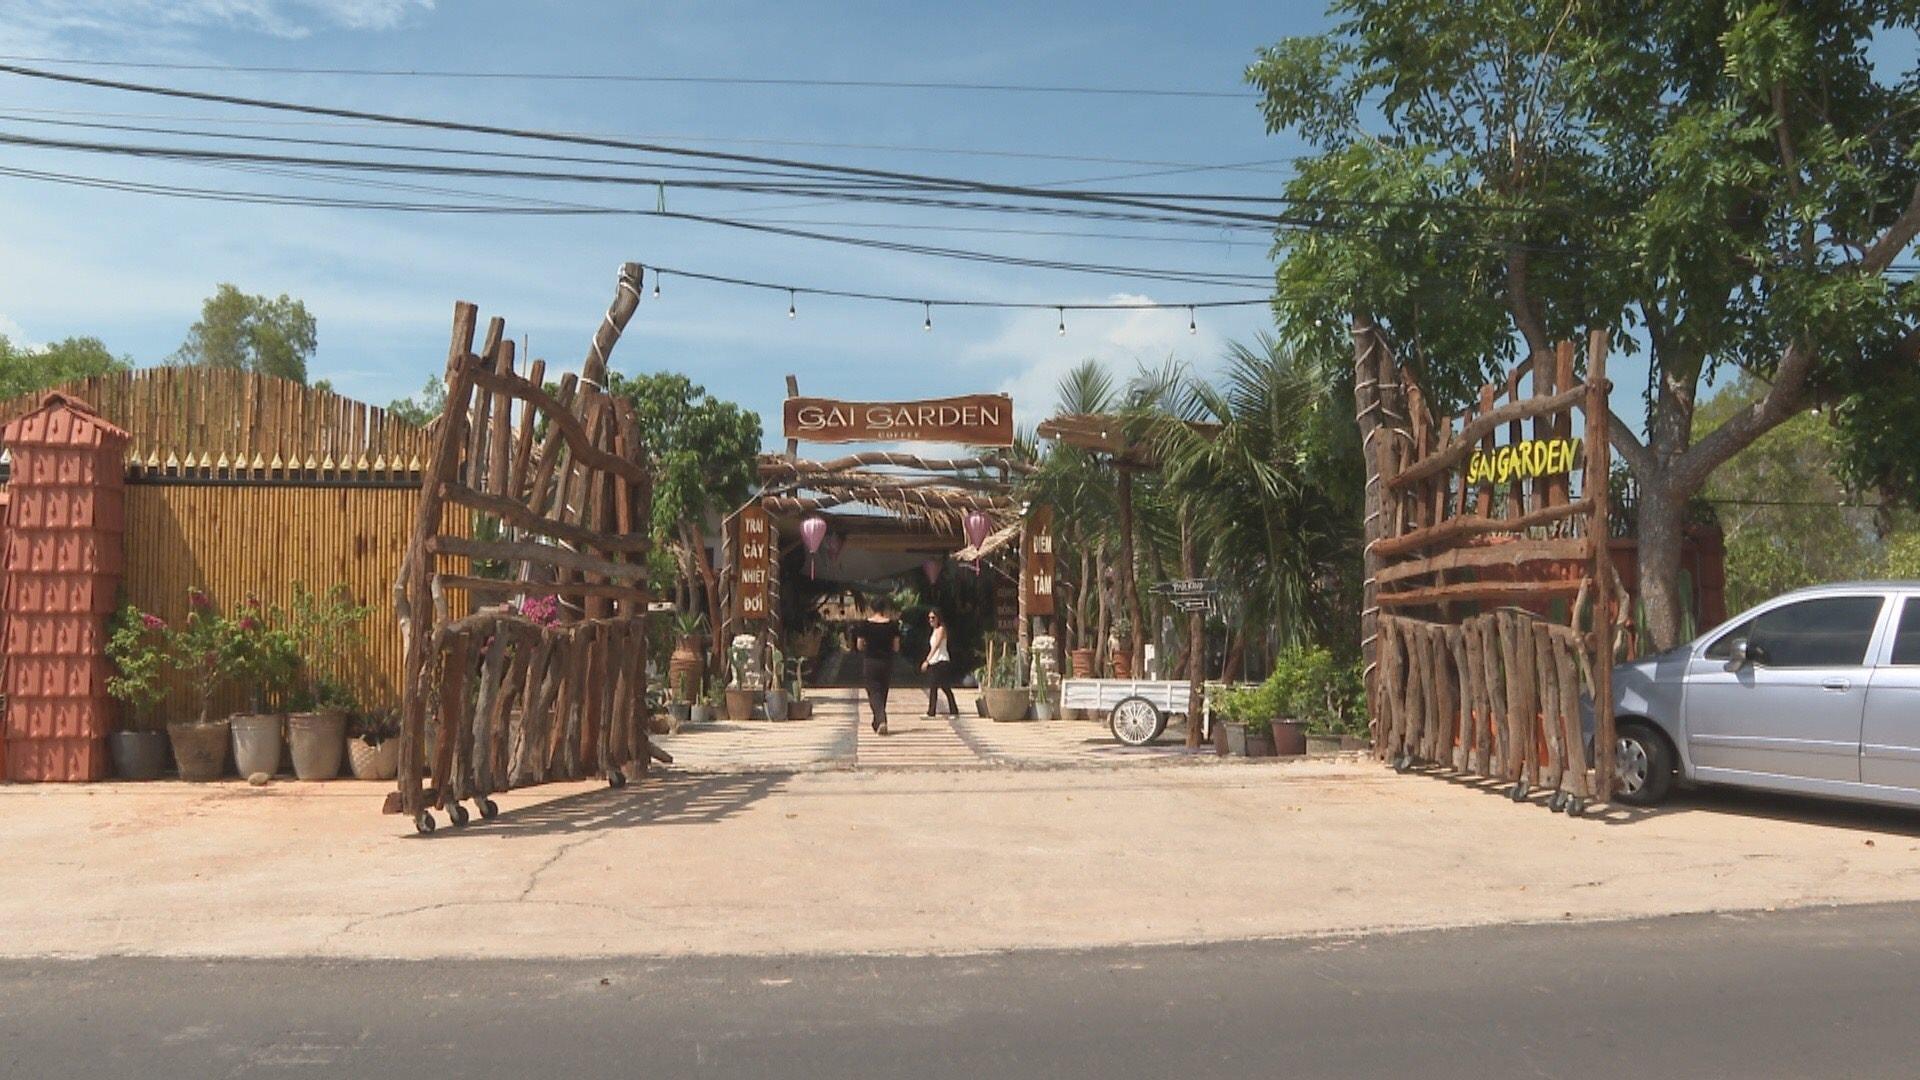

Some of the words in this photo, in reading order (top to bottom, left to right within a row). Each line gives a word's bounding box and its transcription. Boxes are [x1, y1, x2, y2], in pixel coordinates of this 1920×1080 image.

[797, 406, 855, 430] GAI
[866, 406, 999, 429] GARDEN
[878, 431, 921, 439] COFFEE
[1497, 438, 1579, 483] GARDEN
[743, 539, 764, 559] CÂY
[741, 564, 766, 588] NHIỆT
[1033, 568, 1052, 595] TÂM
